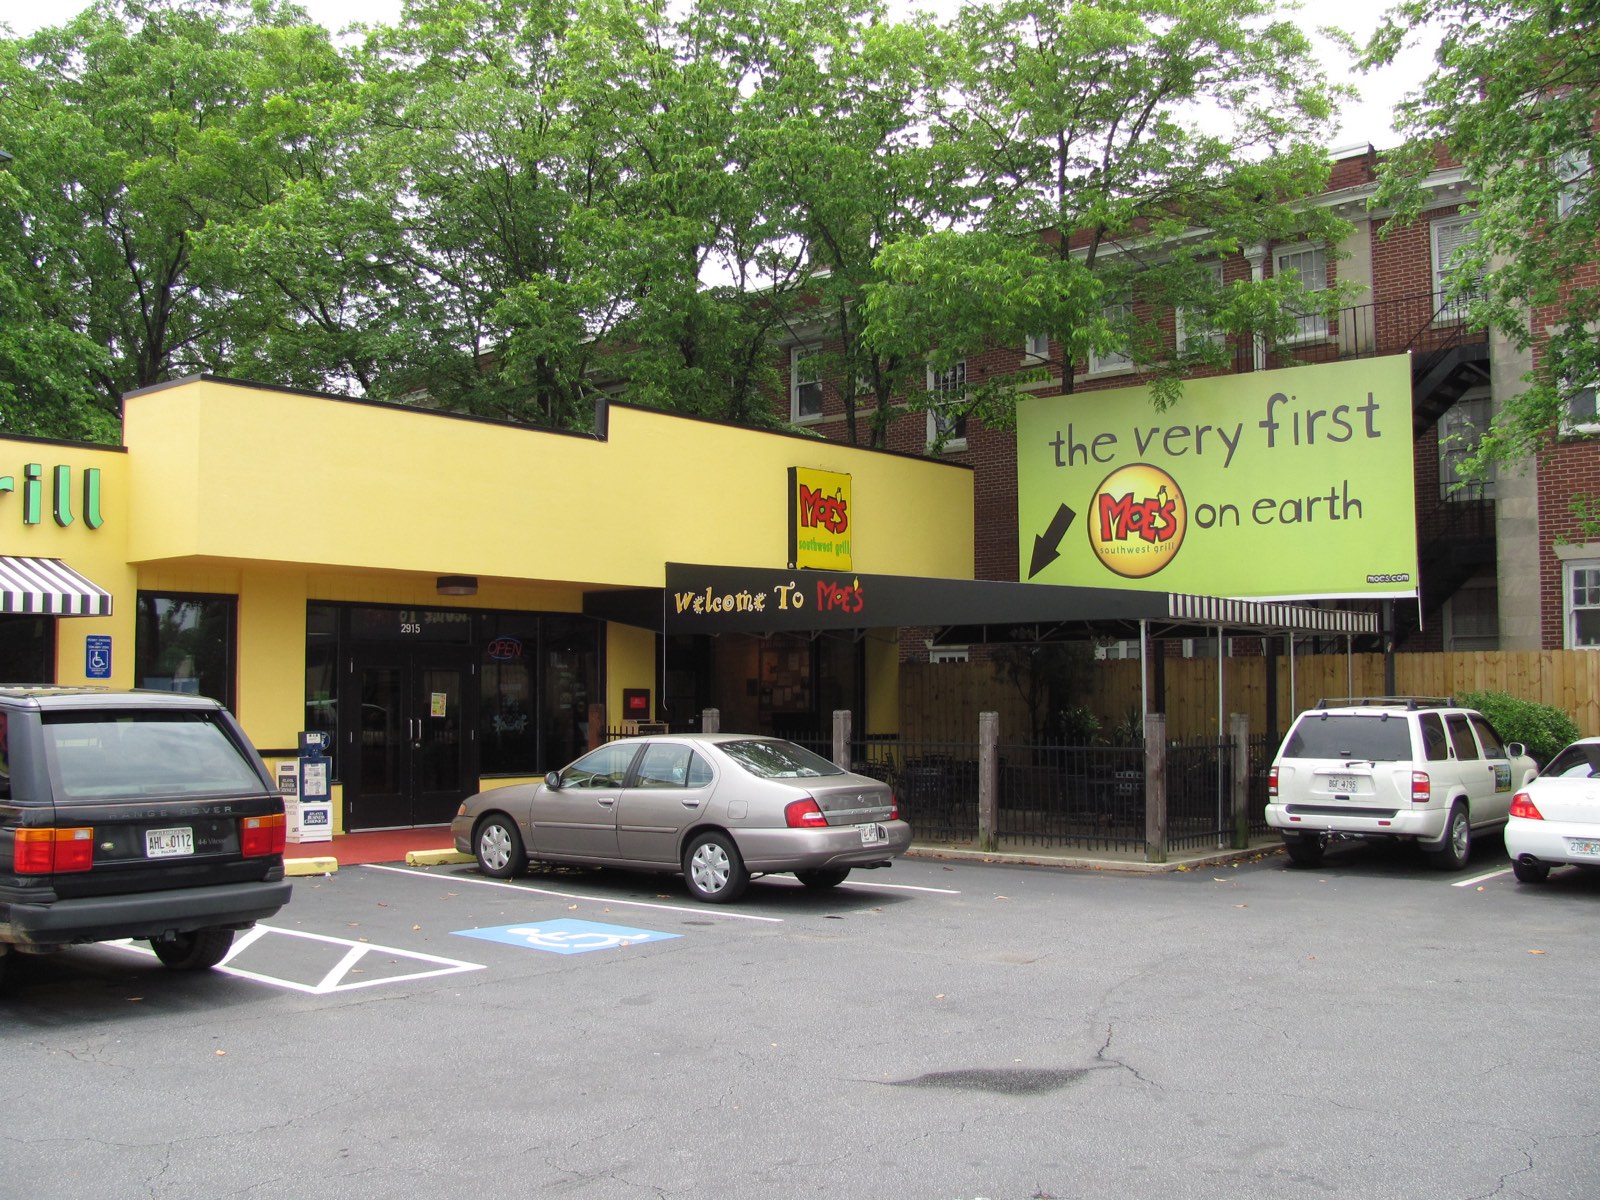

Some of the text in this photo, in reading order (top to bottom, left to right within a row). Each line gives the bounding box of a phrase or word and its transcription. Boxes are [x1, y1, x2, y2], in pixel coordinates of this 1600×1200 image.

[1049, 392, 1382, 468] the very first
[1195, 503, 1240, 529] on
[1251, 479, 1363, 523] earth
[799, 537, 850, 556] southwest grill
[1100, 542, 1175, 554] southwest grill
[1367, 573, 1409, 583] moes.com
[674, 586, 767, 614] Welcome
[774, 581, 804, 609] To
[400, 623, 421, 634] 2915
[487, 641, 523, 657] OPEN
[109, 806, 232, 819] RANGE ROVER
[150, 834, 192, 850] AHL 0112
